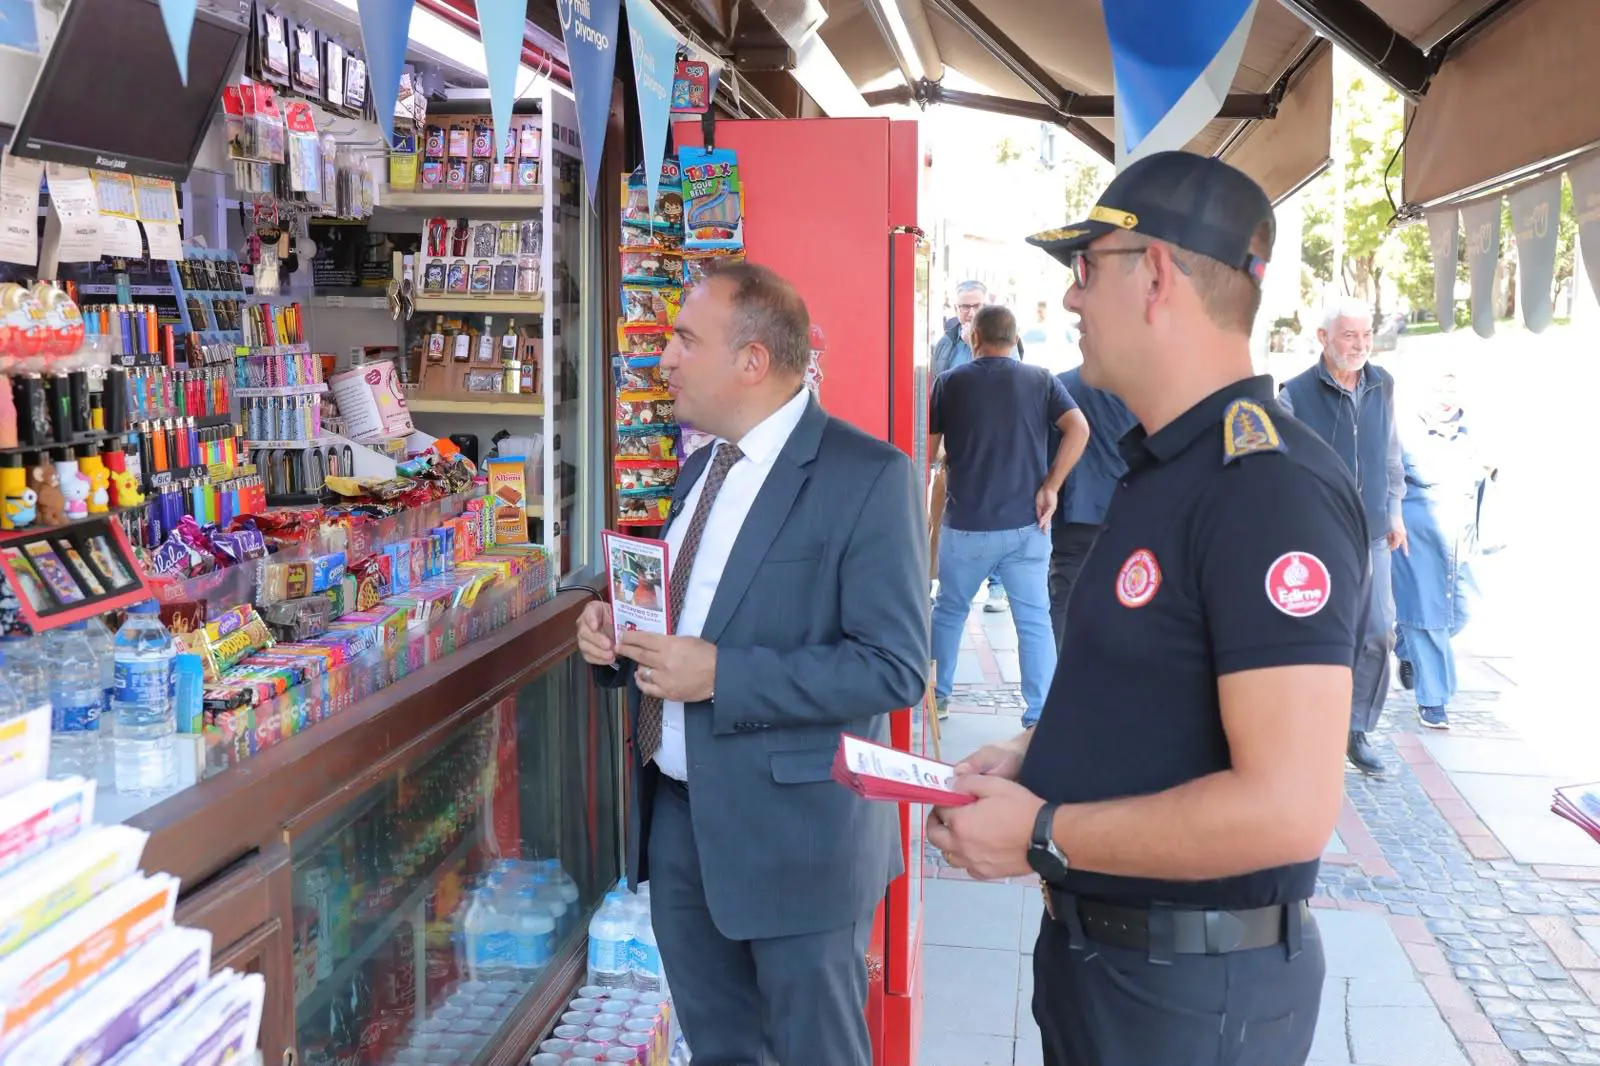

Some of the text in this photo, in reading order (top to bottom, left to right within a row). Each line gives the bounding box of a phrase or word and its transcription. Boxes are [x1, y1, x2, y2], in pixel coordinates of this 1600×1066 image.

[575, 19, 609, 51] piyango
[692, 181, 713, 191] SOUR
[690, 188, 707, 198] BELT
[494, 473, 521, 482] Albeni
[1278, 587, 1322, 603] Edirne
